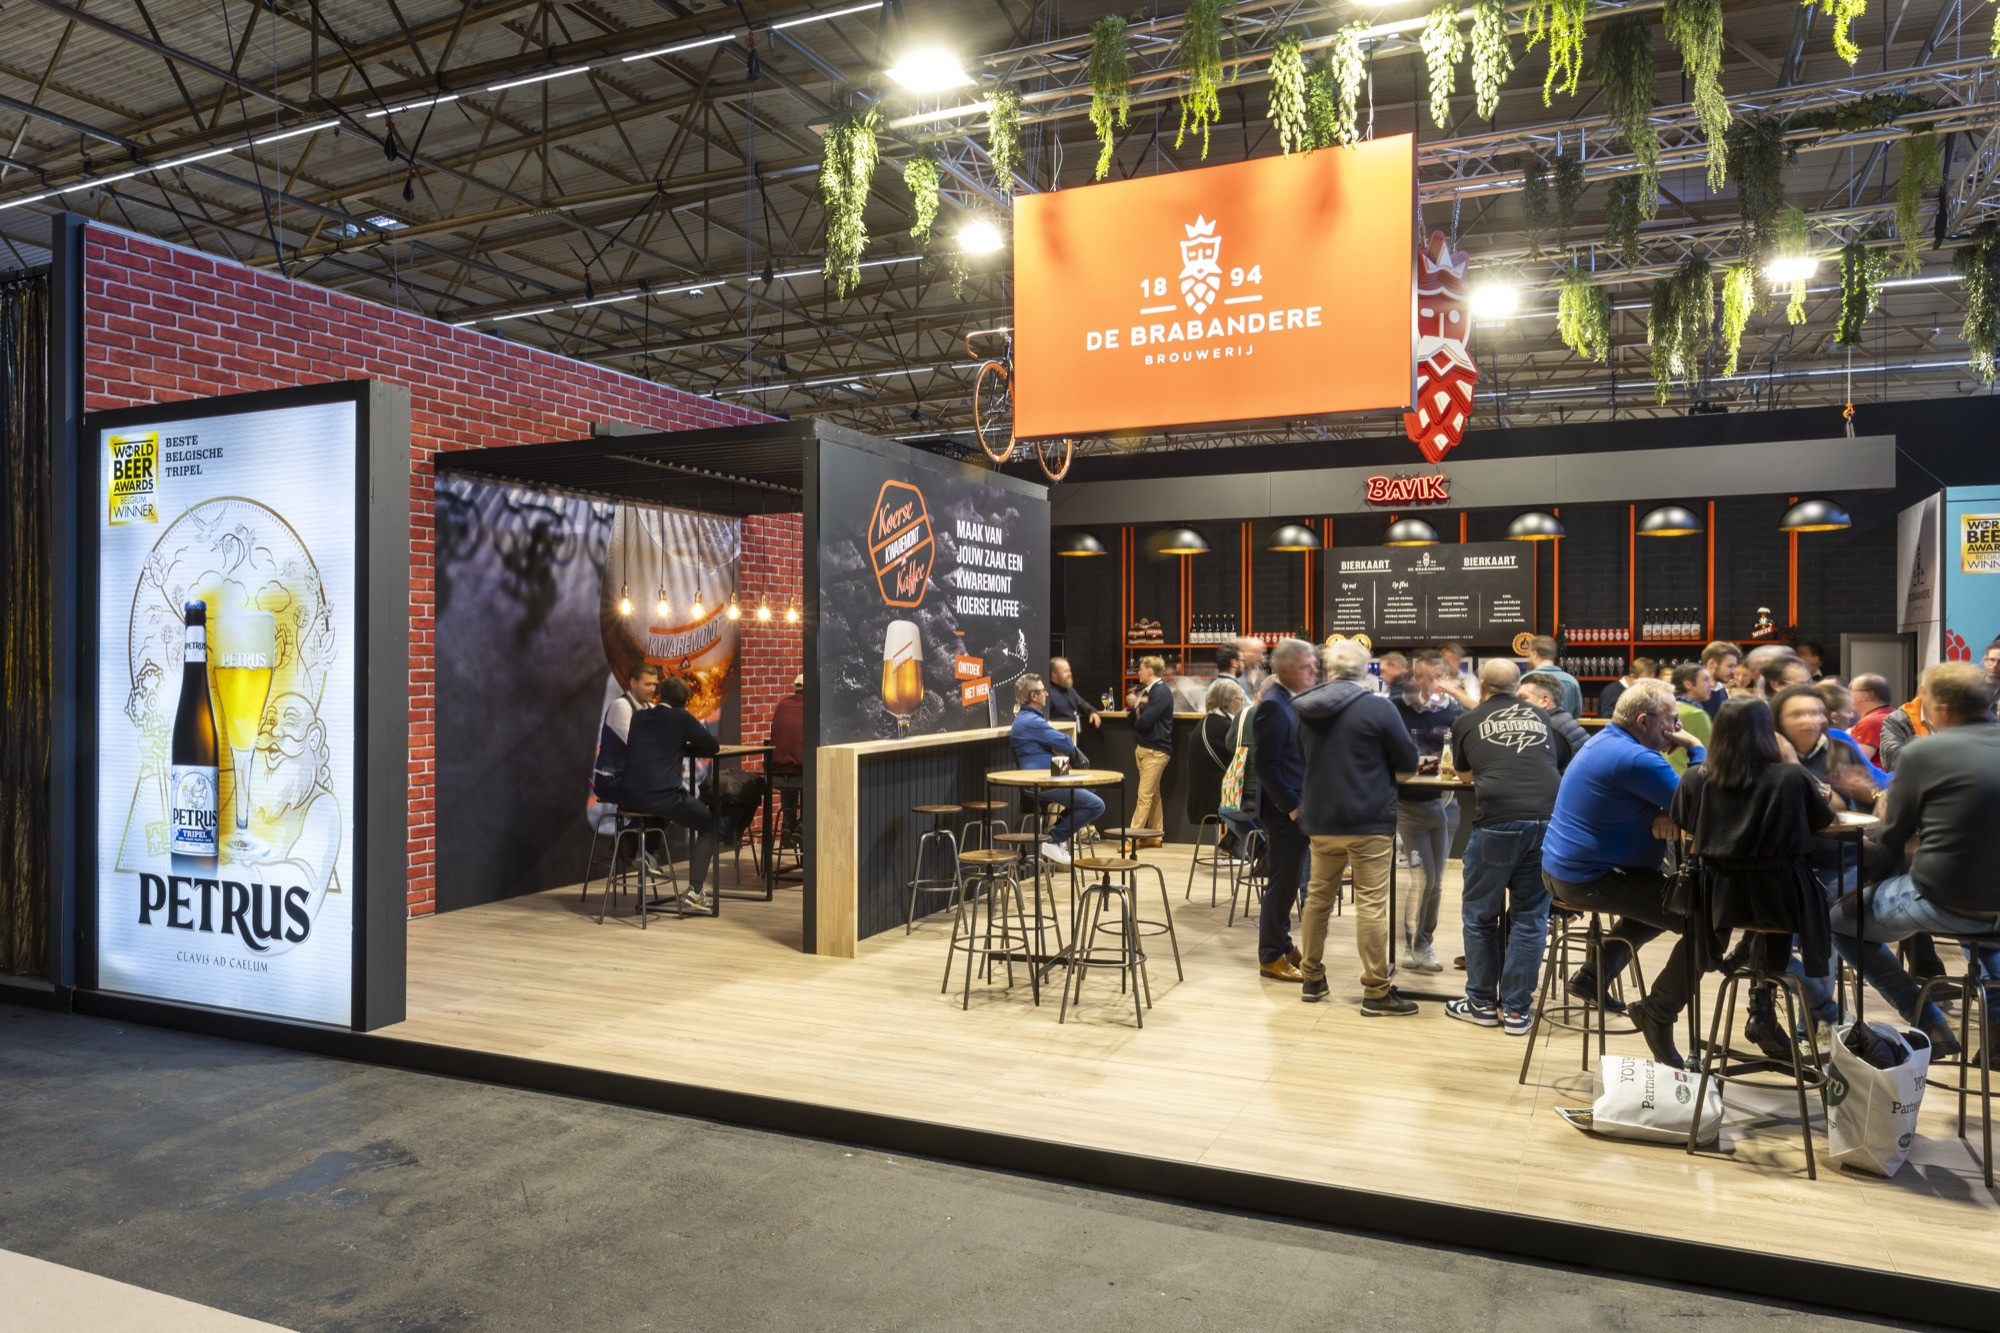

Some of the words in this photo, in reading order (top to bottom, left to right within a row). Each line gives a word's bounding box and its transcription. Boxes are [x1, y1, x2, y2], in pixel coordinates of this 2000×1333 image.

[1140, 277, 1167, 298] 18
[1230, 264, 1262, 287] 94
[1086, 329, 1119, 351] DE
[1130, 306, 1322, 346] BRABANDERE
[1144, 345, 1253, 366] BROUWERIJ
[114, 444, 154, 458] WORLD
[165, 434, 198, 448] BESTE
[165, 448, 224, 462] BELGISCHE
[114, 458, 153, 480] BEER
[165, 465, 203, 478] TRIPEL
[114, 479, 154, 492] AWARDS
[1367, 474, 1448, 501] BAVIK
[114, 504, 154, 518] WINNER
[120, 495, 147, 505] BELGIUM
[878, 501, 914, 540] Koerse
[956, 519, 984, 542] MAAK
[984, 524, 1002, 546] VAN
[885, 526, 920, 564] KWAREMONT
[956, 545, 982, 567] JOUW
[984, 548, 1006, 570] ZAAK
[1008, 554, 1022, 572] EEN
[1341, 560, 1390, 570] BIERKAART
[1464, 556, 1516, 567] BIERKAART
[896, 558, 926, 598] Kaffee
[956, 570, 1012, 594] KWAREMONT
[956, 596, 990, 616] KOERSE
[991, 598, 1019, 618] KAFFEE
[184, 642, 206, 651] PETRUS
[647, 615, 721, 658] KWAREMONT
[222, 652, 266, 670] PETRUS
[958, 662, 980, 676] ONTDEK
[965, 687, 975, 700] HET
[976, 683, 990, 697] HIER
[173, 808, 218, 830] PETRUS
[182, 830, 208, 838] TRIPEL
[138, 872, 310, 951] PETRUS
[176, 951, 210, 965] CLAVIS
[213, 956, 226, 967] AD
[229, 957, 268, 973] CAELUM
[1642, 1068, 1655, 1110] Partner
